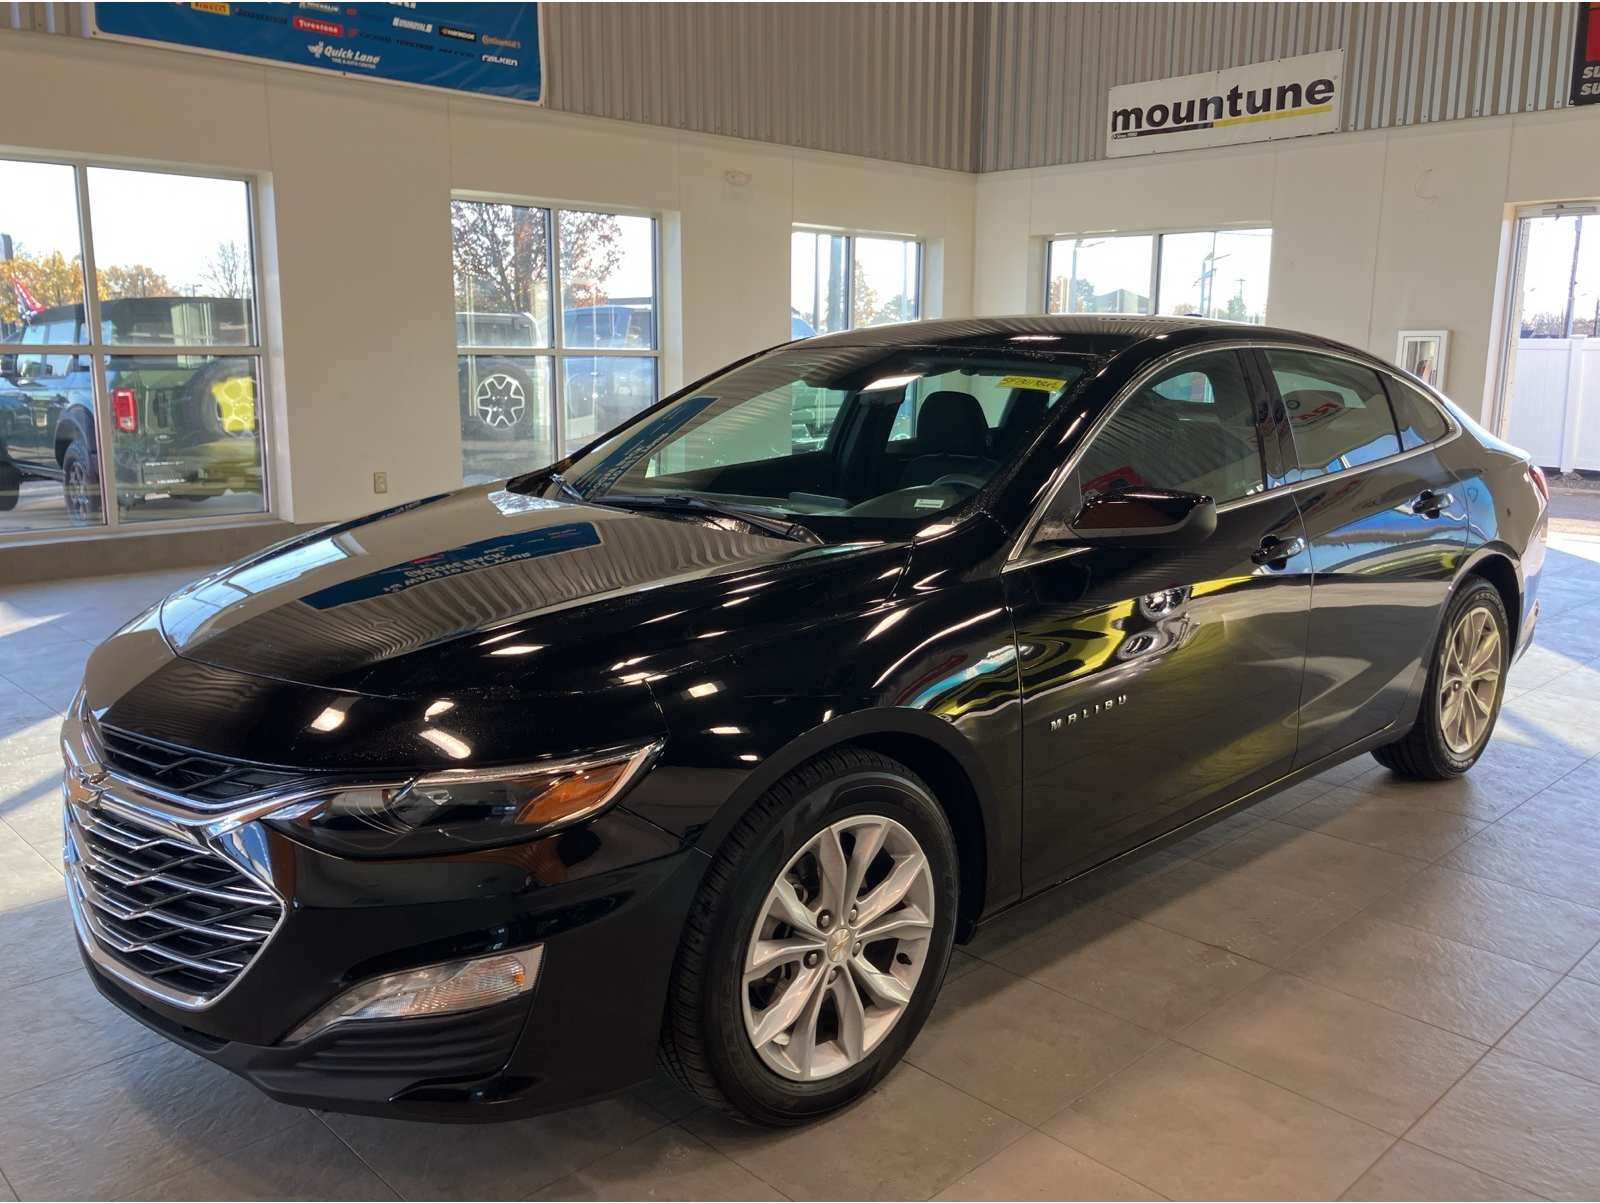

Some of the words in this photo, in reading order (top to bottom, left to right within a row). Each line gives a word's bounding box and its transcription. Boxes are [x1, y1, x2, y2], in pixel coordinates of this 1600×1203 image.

[324, 45, 353, 59] Quick
[354, 51, 380, 63] Lane
[1111, 78, 1336, 132] mountune
[1050, 694, 1127, 732] MALIBU
